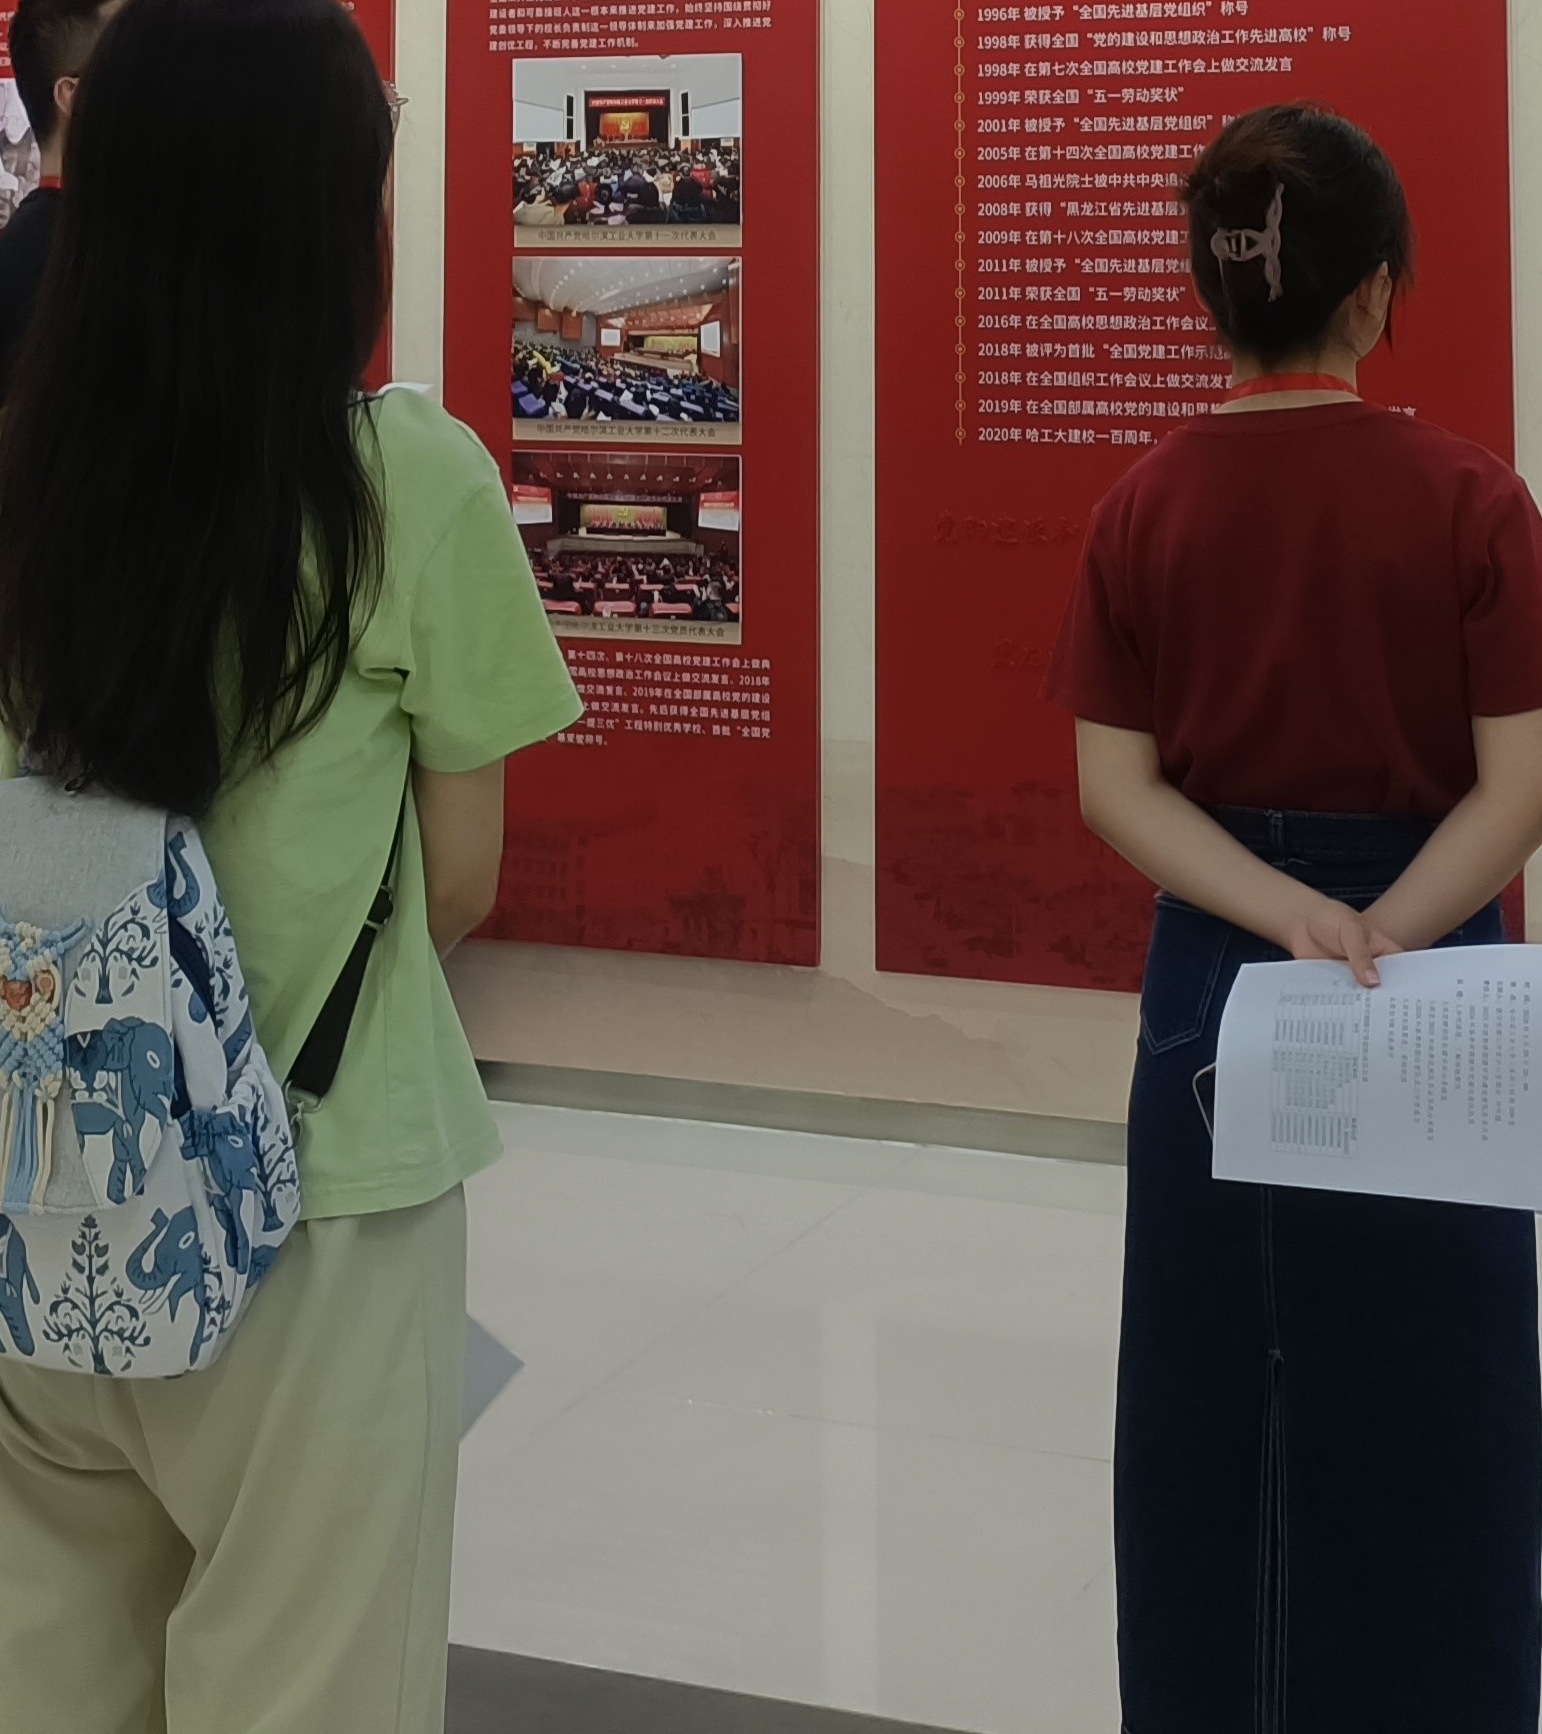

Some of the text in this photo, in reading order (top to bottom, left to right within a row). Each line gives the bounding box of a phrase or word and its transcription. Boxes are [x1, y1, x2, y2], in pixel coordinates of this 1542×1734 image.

[977, 0, 1249, 21] 1996年 被授予“全国先进基层党组织”称号
[977, 35, 1020, 49] 1998年
[977, 57, 1293, 77] 1998年 在第七次全国高校党建工作会上做交流发言
[977, 87, 1184, 105] 1999年 荣获全国“五一劳动奖状”
[977, 118, 1021, 133] 2001年
[977, 146, 1021, 161] 2005年
[977, 174, 1021, 188] 2006年
[977, 202, 1021, 216] 2008年
[977, 230, 1021, 245] 2009年
[977, 258, 1021, 273] 2011年
[977, 286, 1186, 302] 2011年 荣获全国“五一劳动奖状”
[977, 314, 1217, 331] 2016年 在全国高校思想政治工作会议
[978, 343, 1022, 357] 2018年
[978, 371, 1022, 386] 2018年
[978, 399, 1022, 414] 2019年
[978, 428, 1022, 442] 2020年
